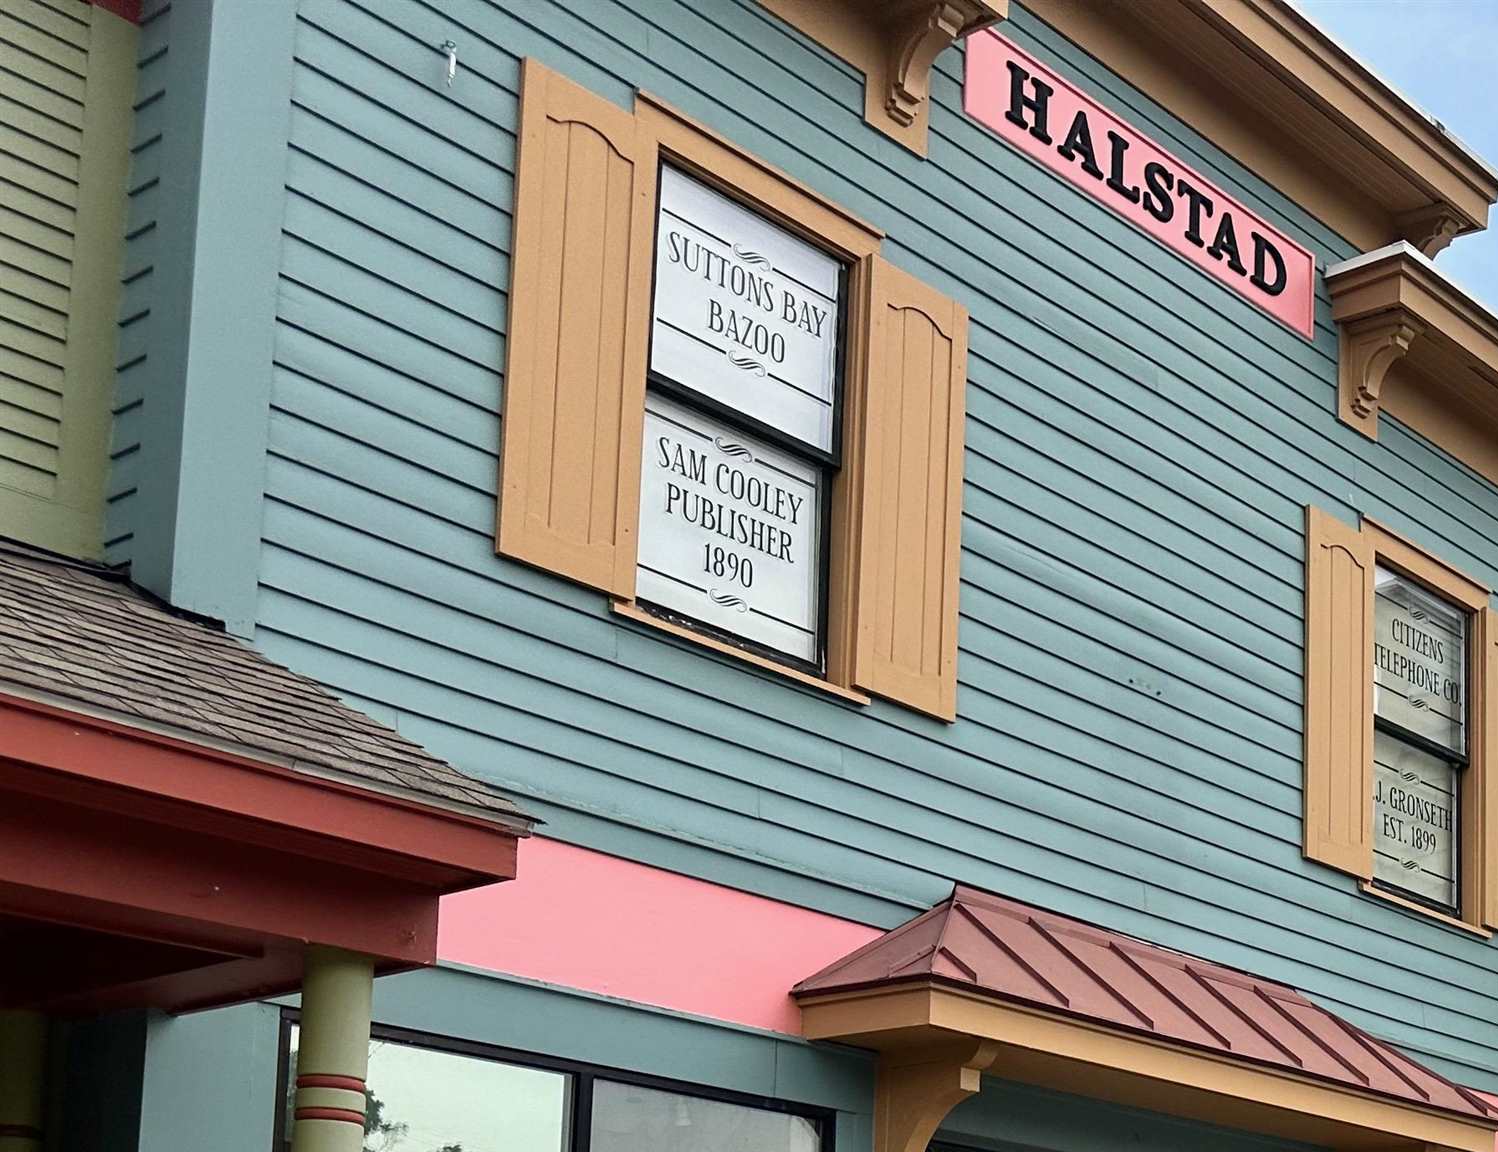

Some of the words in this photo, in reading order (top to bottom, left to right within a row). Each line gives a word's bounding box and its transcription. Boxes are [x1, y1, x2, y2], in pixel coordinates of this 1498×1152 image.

[1005, 60, 1287, 296] HALSTAD
[668, 231, 774, 313] SUTTONS
[781, 289, 828, 339] BAY
[708, 299, 785, 364] BAZOO
[657, 437, 706, 487] SAM
[716, 463, 803, 525] COOLEY
[665, 483, 794, 564] PUBLISHER
[703, 543, 753, 588] 1890
[1374, 642, 1440, 696] TELEPHONE
[1392, 618, 1444, 664] CITIZENS
[1383, 813, 1407, 844] EST.
[1411, 826, 1437, 855] 1899
[1390, 787, 1453, 833] GRONSETH
